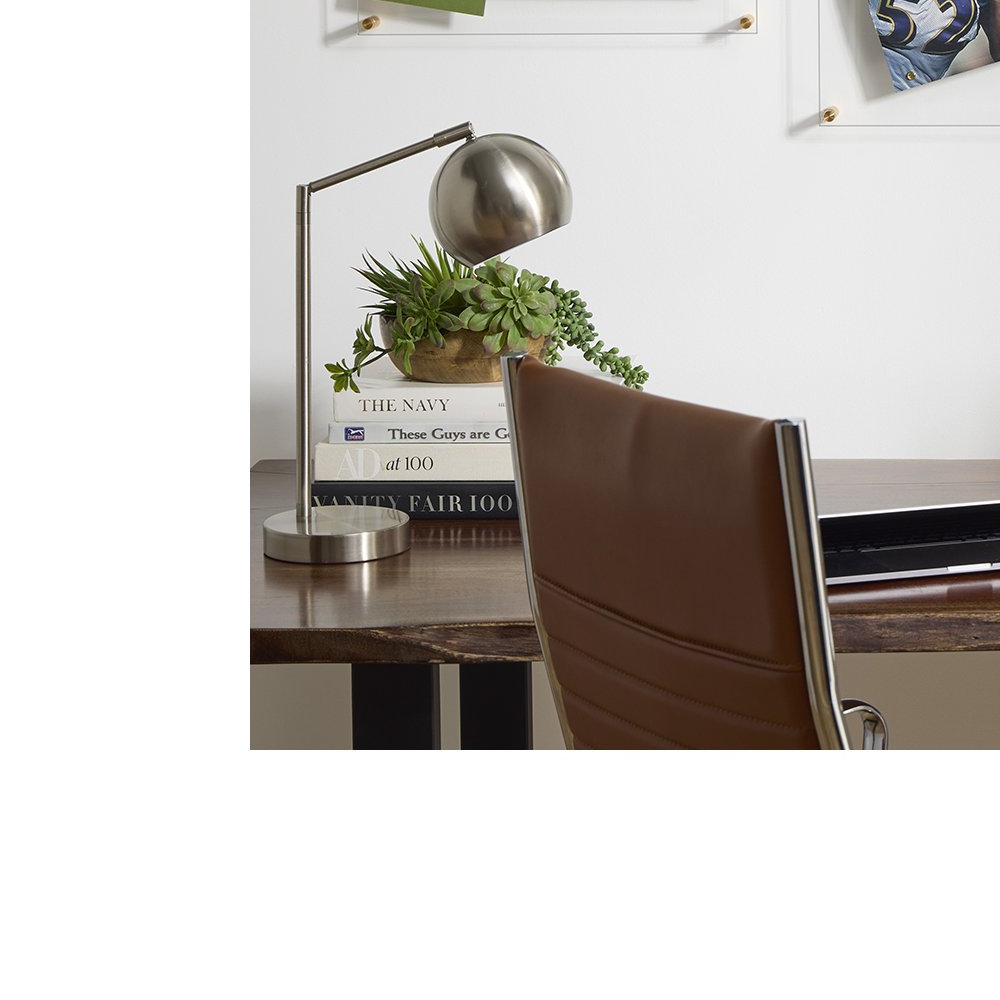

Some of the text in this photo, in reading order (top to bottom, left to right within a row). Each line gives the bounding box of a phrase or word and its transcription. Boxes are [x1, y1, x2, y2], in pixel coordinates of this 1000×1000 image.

[359, 399, 450, 412] THE NAVY
[387, 428, 427, 440] These
[431, 428, 466, 442] Guys
[470, 431, 490, 440] are
[337, 448, 434, 480] AD at 100
[408, 495, 464, 512] FAIR
